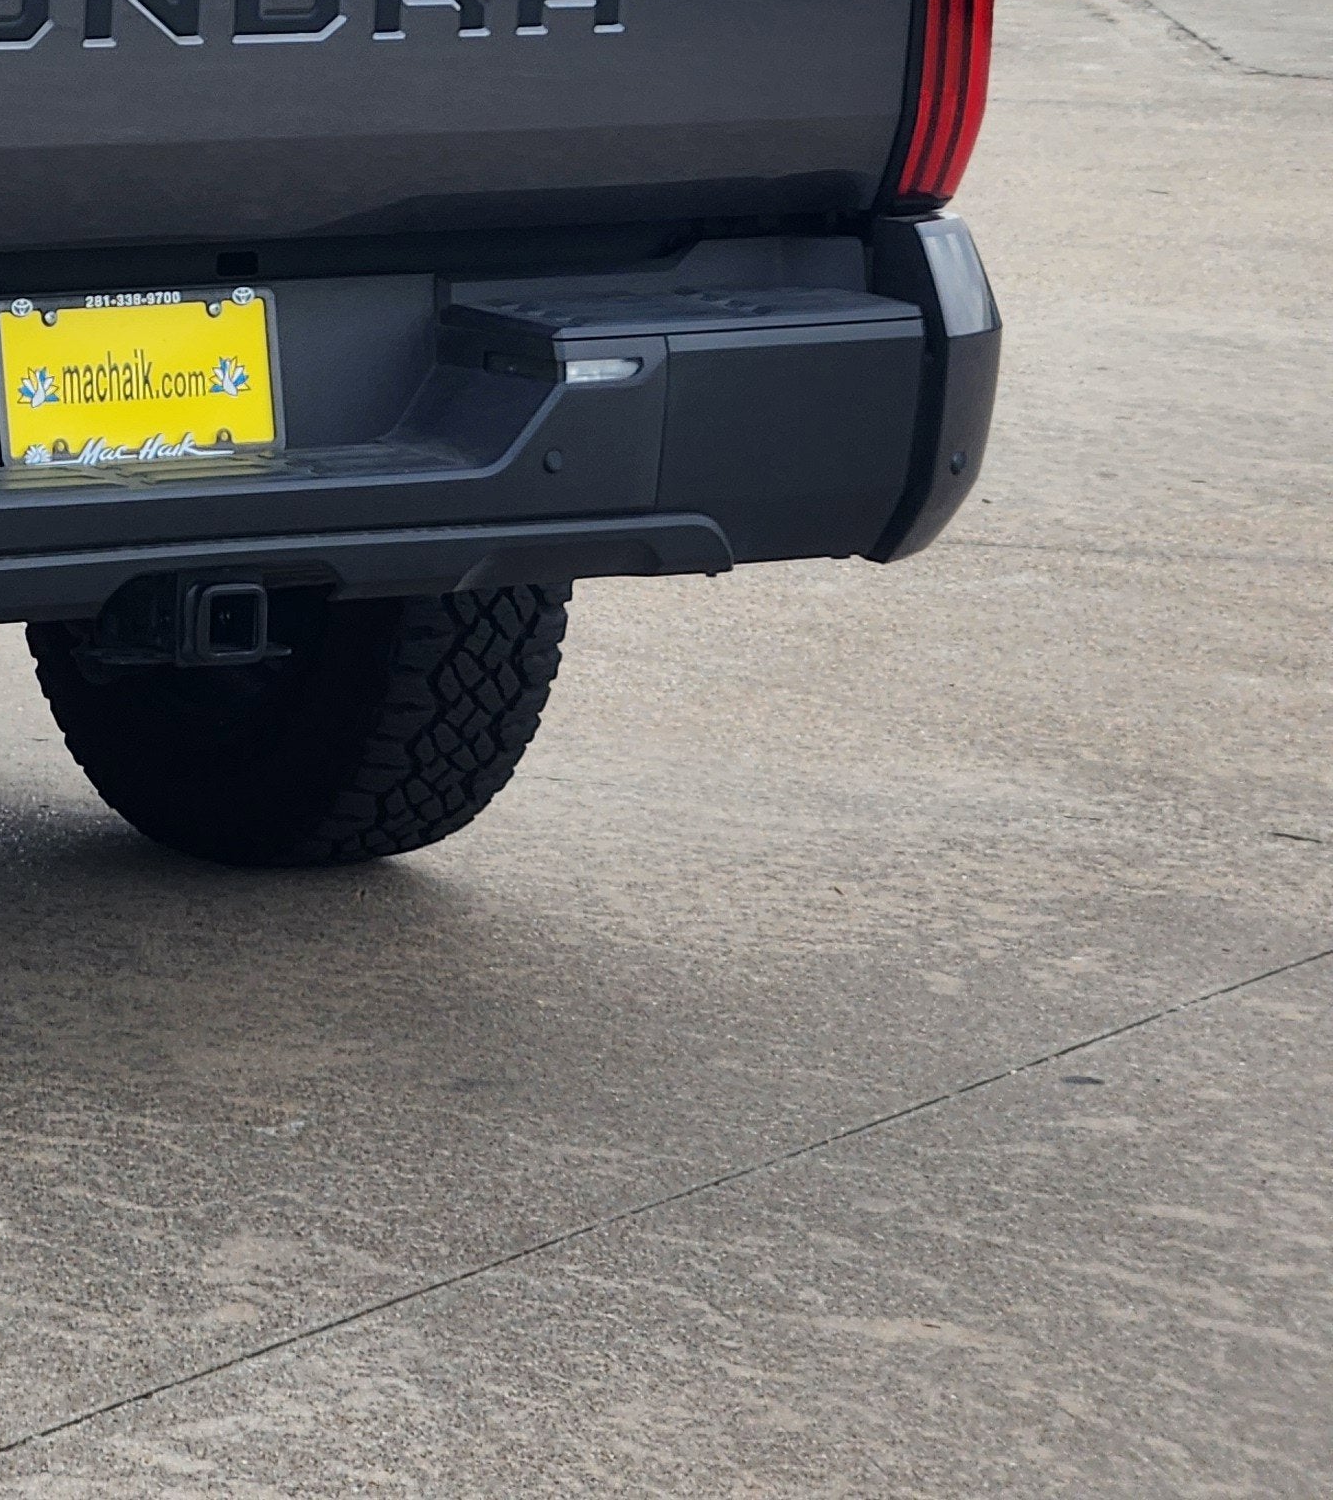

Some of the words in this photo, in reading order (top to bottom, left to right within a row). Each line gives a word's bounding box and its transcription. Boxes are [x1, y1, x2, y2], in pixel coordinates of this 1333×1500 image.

[62, 349, 207, 404] machaik.com
[57, 437, 137, 465] Mac
[137, 432, 221, 461] Haik
